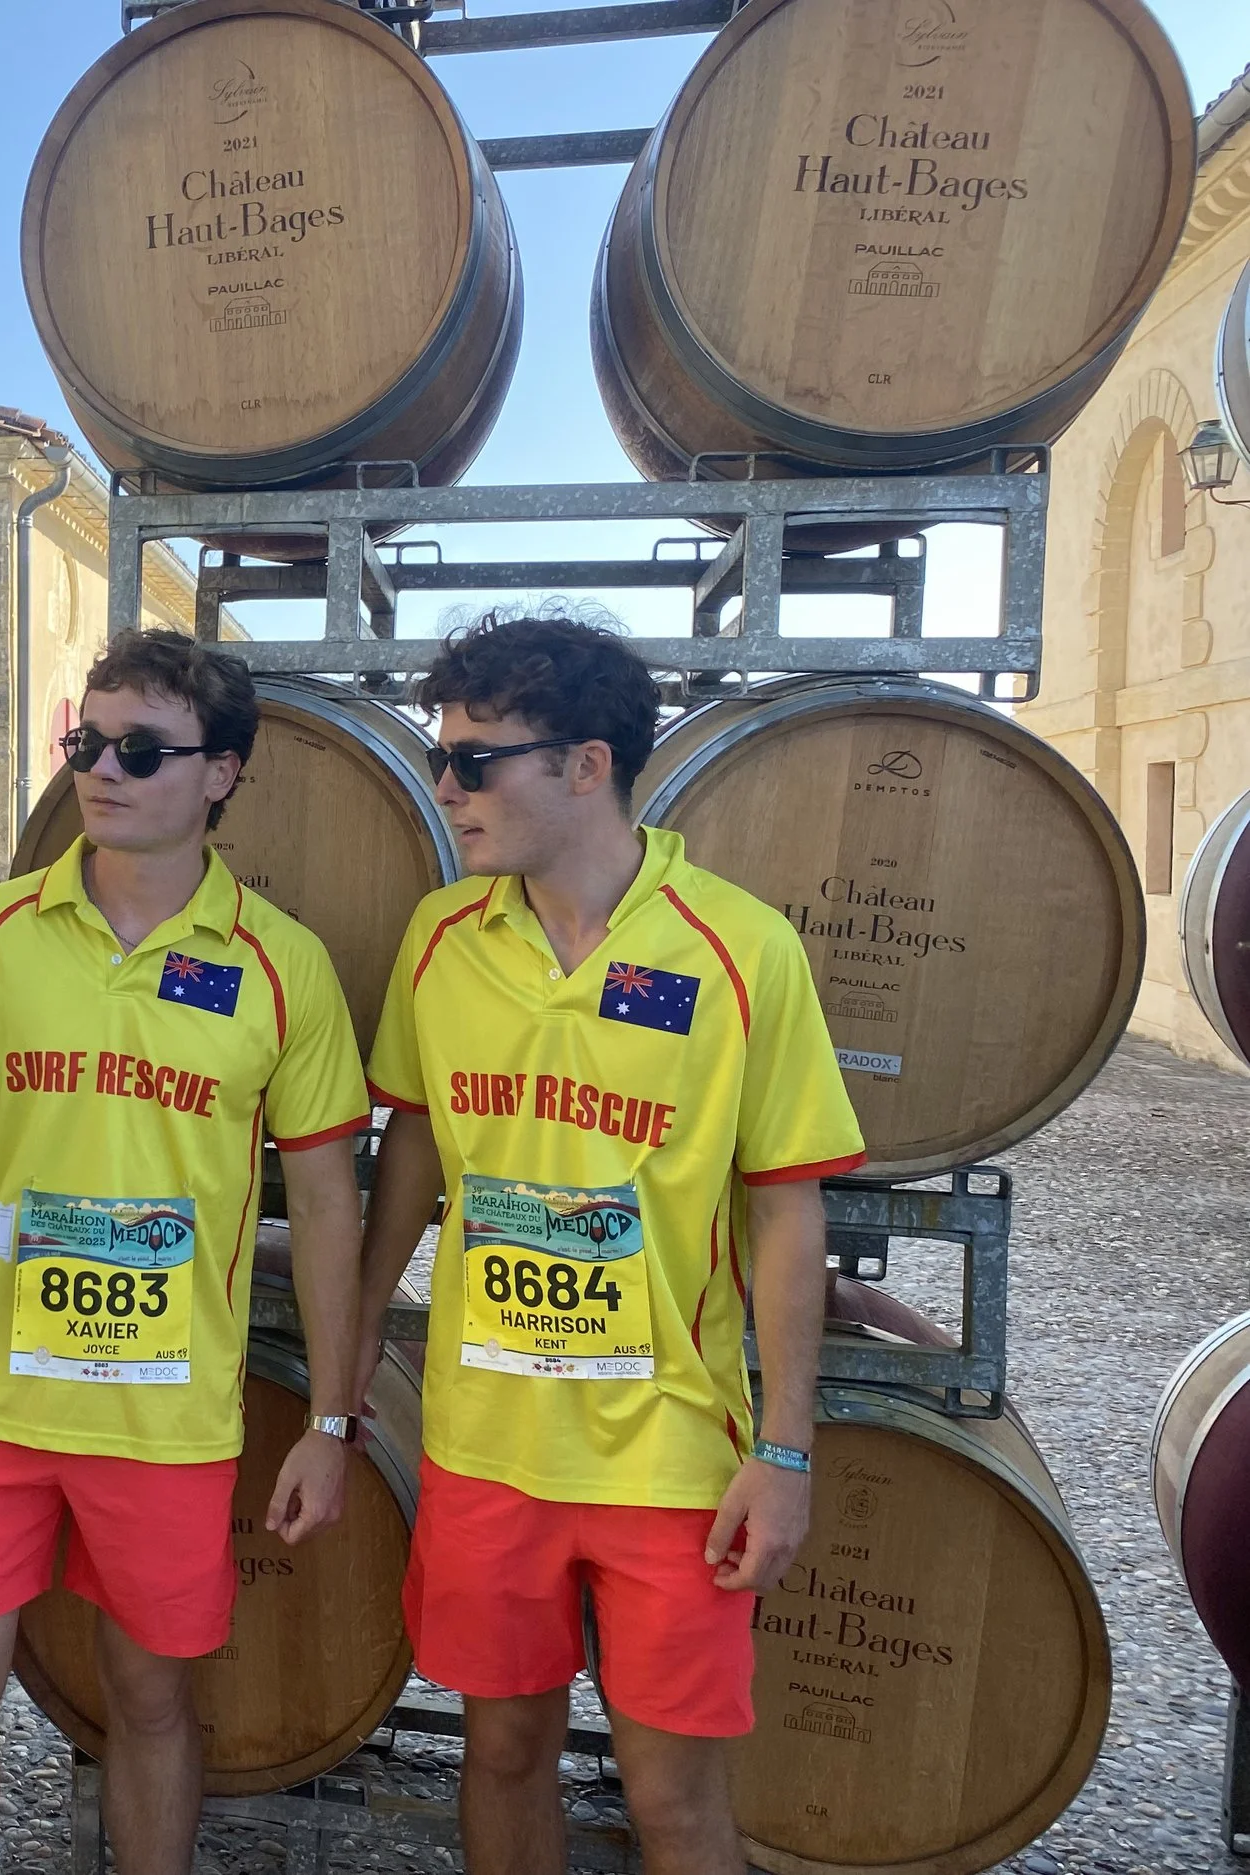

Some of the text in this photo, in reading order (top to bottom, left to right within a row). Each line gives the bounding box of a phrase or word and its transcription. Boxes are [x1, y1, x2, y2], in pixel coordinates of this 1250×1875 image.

[903, 84, 945, 100] 2021
[845, 113, 990, 151] Château
[223, 136, 258, 152] 2021
[181, 168, 304, 201] Château
[793, 155, 1029, 211] Haut-Bages
[859, 205, 950, 226] LIBÉRAL
[146, 201, 345, 249] Haut-Bages
[207, 246, 284, 266] LIBÉRAL
[854, 243, 945, 258] PAUILLAC
[208, 278, 285, 296] PAUILLAC
[867, 373, 891, 385] CLR
[241, 399, 262, 410] CLR
[854, 783, 930, 797] DEMPTOS
[870, 857, 898, 868] 2020
[821, 876, 935, 913] Château
[784, 903, 966, 958] Haut-Bages
[833, 949, 905, 967] LIBÉRAL
[829, 976, 901, 992] PAUILLAC
[6, 1051, 221, 1118] SURF RESCUE
[873, 1074, 900, 1084] blanc
[451, 1071, 676, 1148] SURF RESCUE
[472, 1192, 541, 1214] MARATHON
[31, 1206, 106, 1226] MARATHON
[486, 1208, 526, 1220] CHÂTEAUX
[48, 1222, 90, 1234] CHÂTEAUX
[517, 1224, 543, 1235] 2025
[79, 1237, 106, 1246] 2025
[41, 1267, 169, 1318] 8683
[484, 1255, 622, 1312] 8684
[66, 1319, 139, 1339] XAVIER
[501, 1309, 606, 1334] HARRISON
[83, 1344, 120, 1355] JOYCE
[535, 1337, 567, 1350] KENT
[614, 1345, 636, 1354] AUS
[155, 1350, 175, 1359] AUS
[830, 1543, 870, 1561] 2021
[778, 1563, 915, 1616] Château
[793, 1650, 879, 1677] LIBÉRAL
[789, 1682, 874, 1707] PAUILLAC
[805, 1804, 828, 1817] CLR
